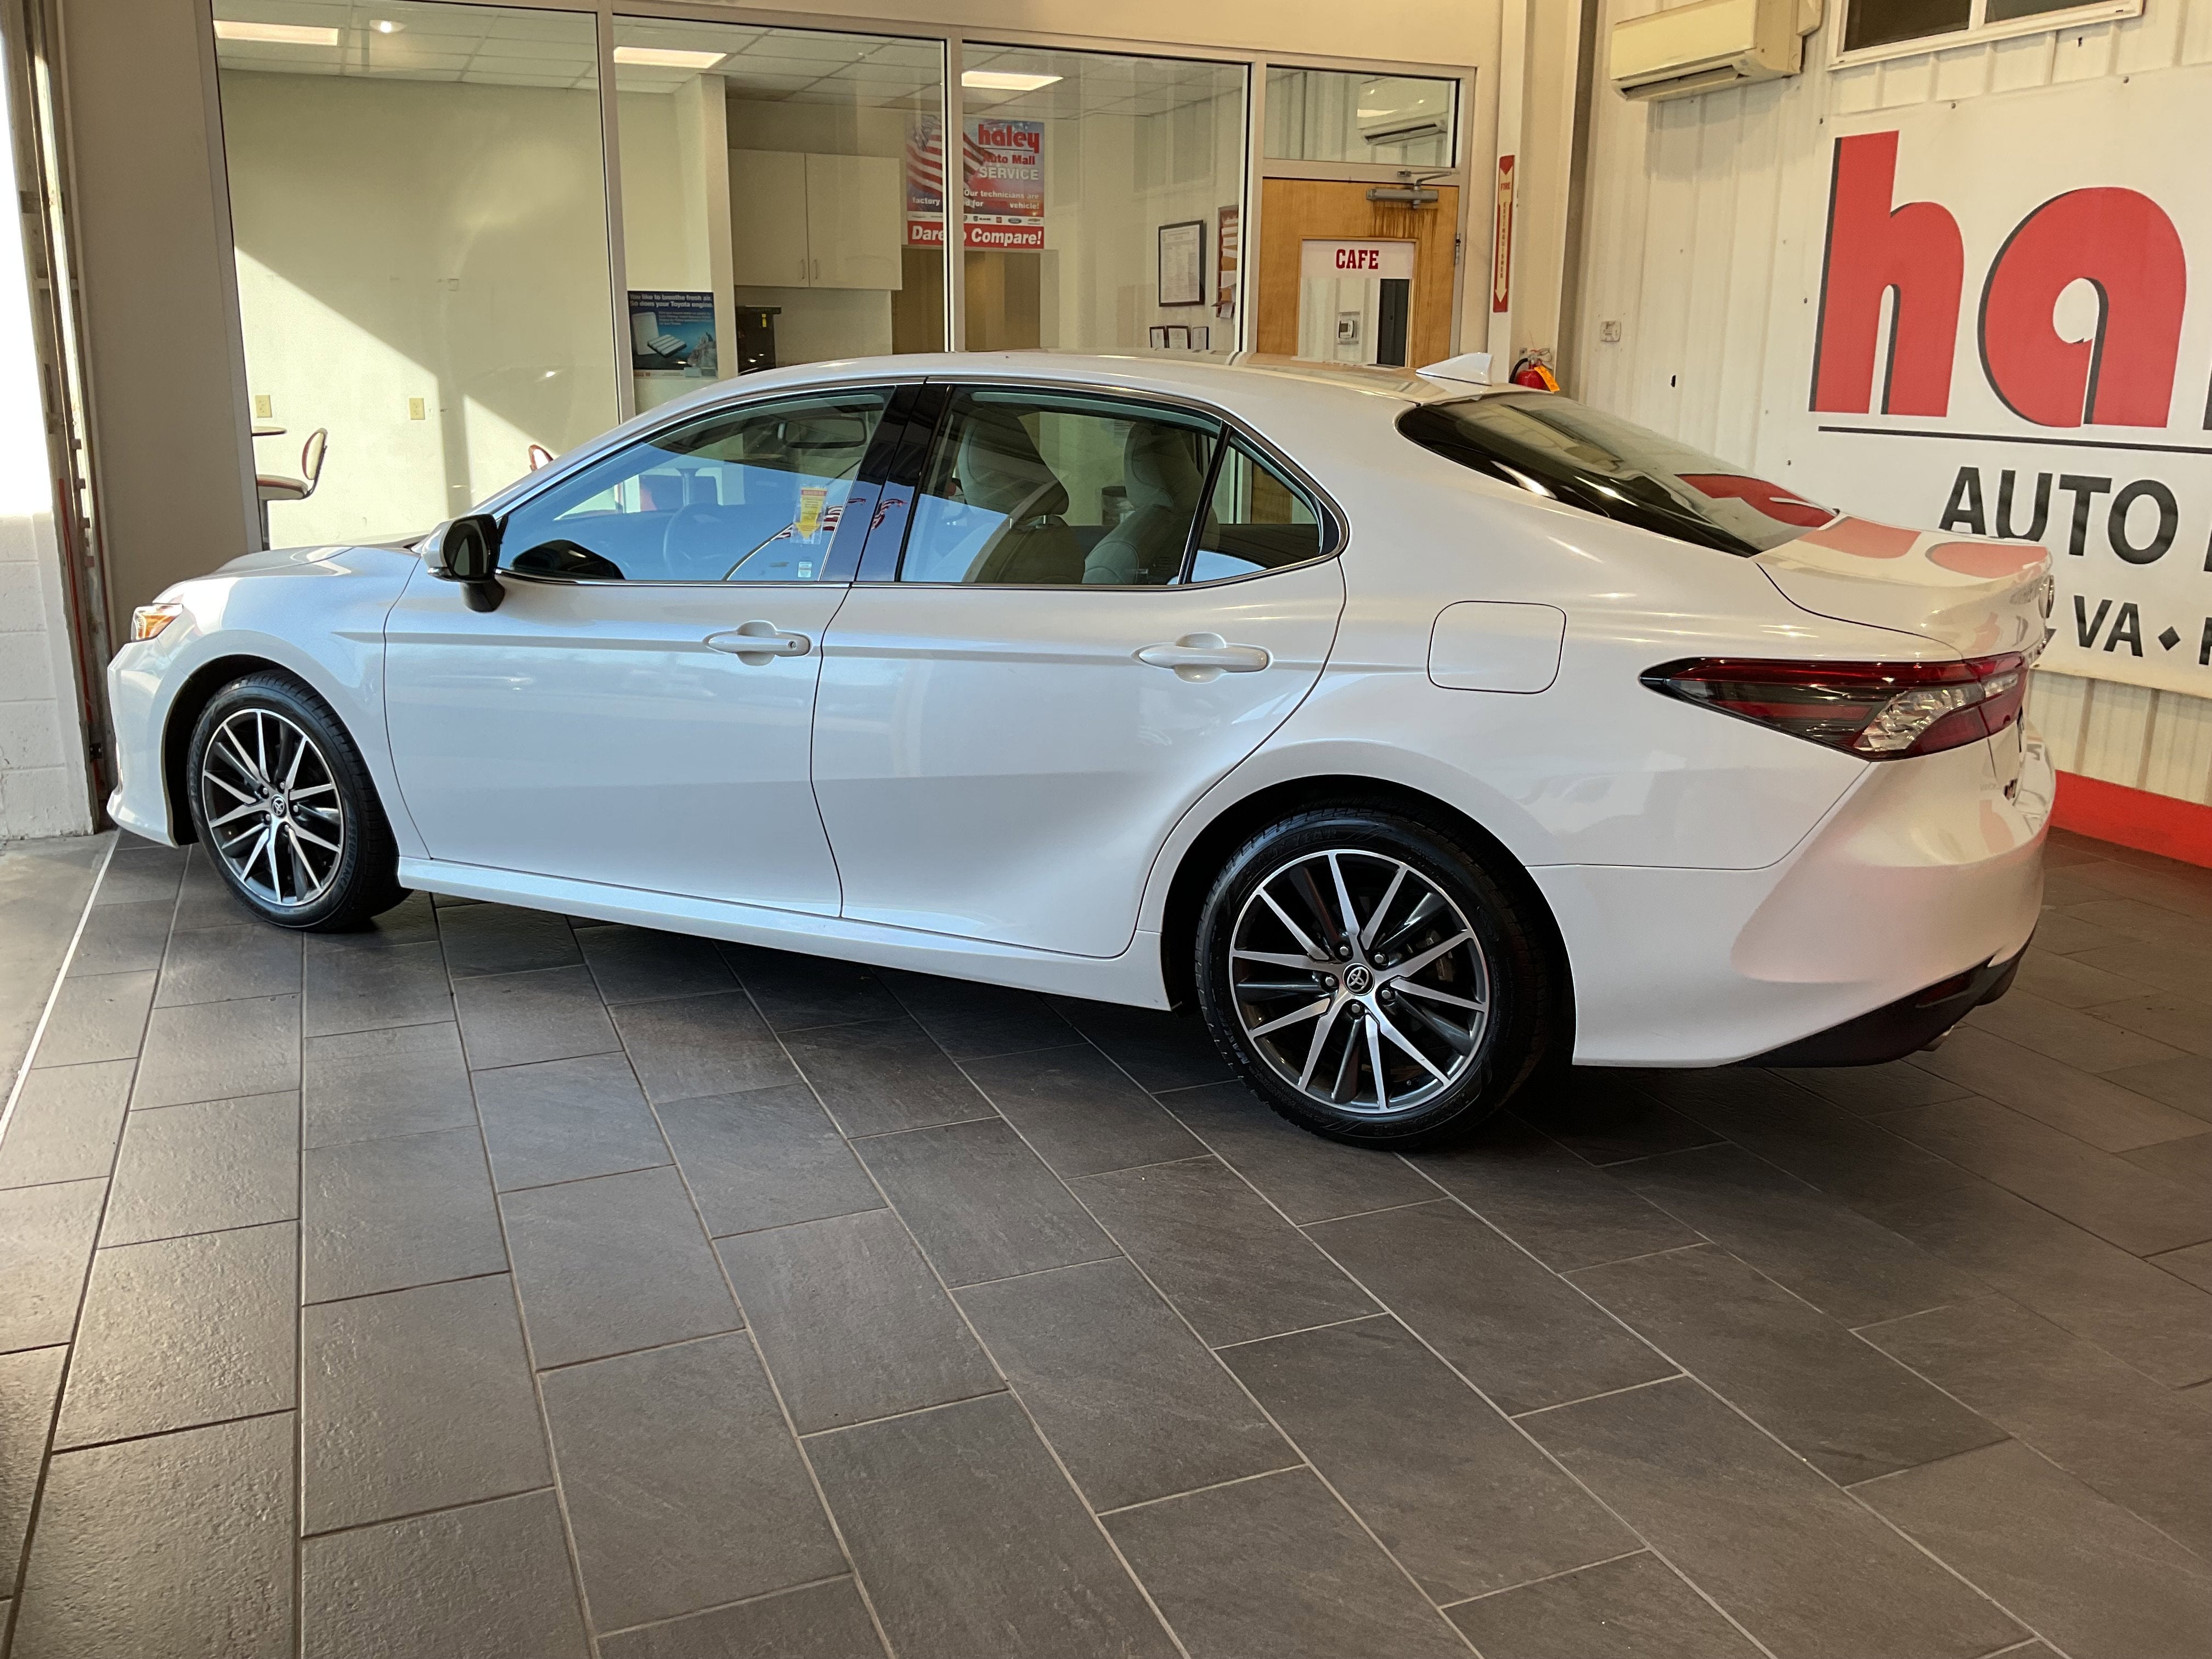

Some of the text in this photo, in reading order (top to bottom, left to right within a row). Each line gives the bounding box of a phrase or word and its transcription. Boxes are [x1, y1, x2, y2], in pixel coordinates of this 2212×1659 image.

[978, 123, 1040, 154] haley
[983, 154, 1036, 165] Auto Mall
[979, 166, 1040, 180] SERVICE
[980, 190, 1025, 199] technicians
[1500, 182, 1510, 191] FIRE
[912, 196, 940, 206] factory
[971, 228, 1042, 247] Compare!
[1335, 249, 1379, 269] CAFE
[1809, 129, 2212, 431] ha
[1938, 466, 2178, 565] AUTO
[2074, 595, 2143, 657] VA
